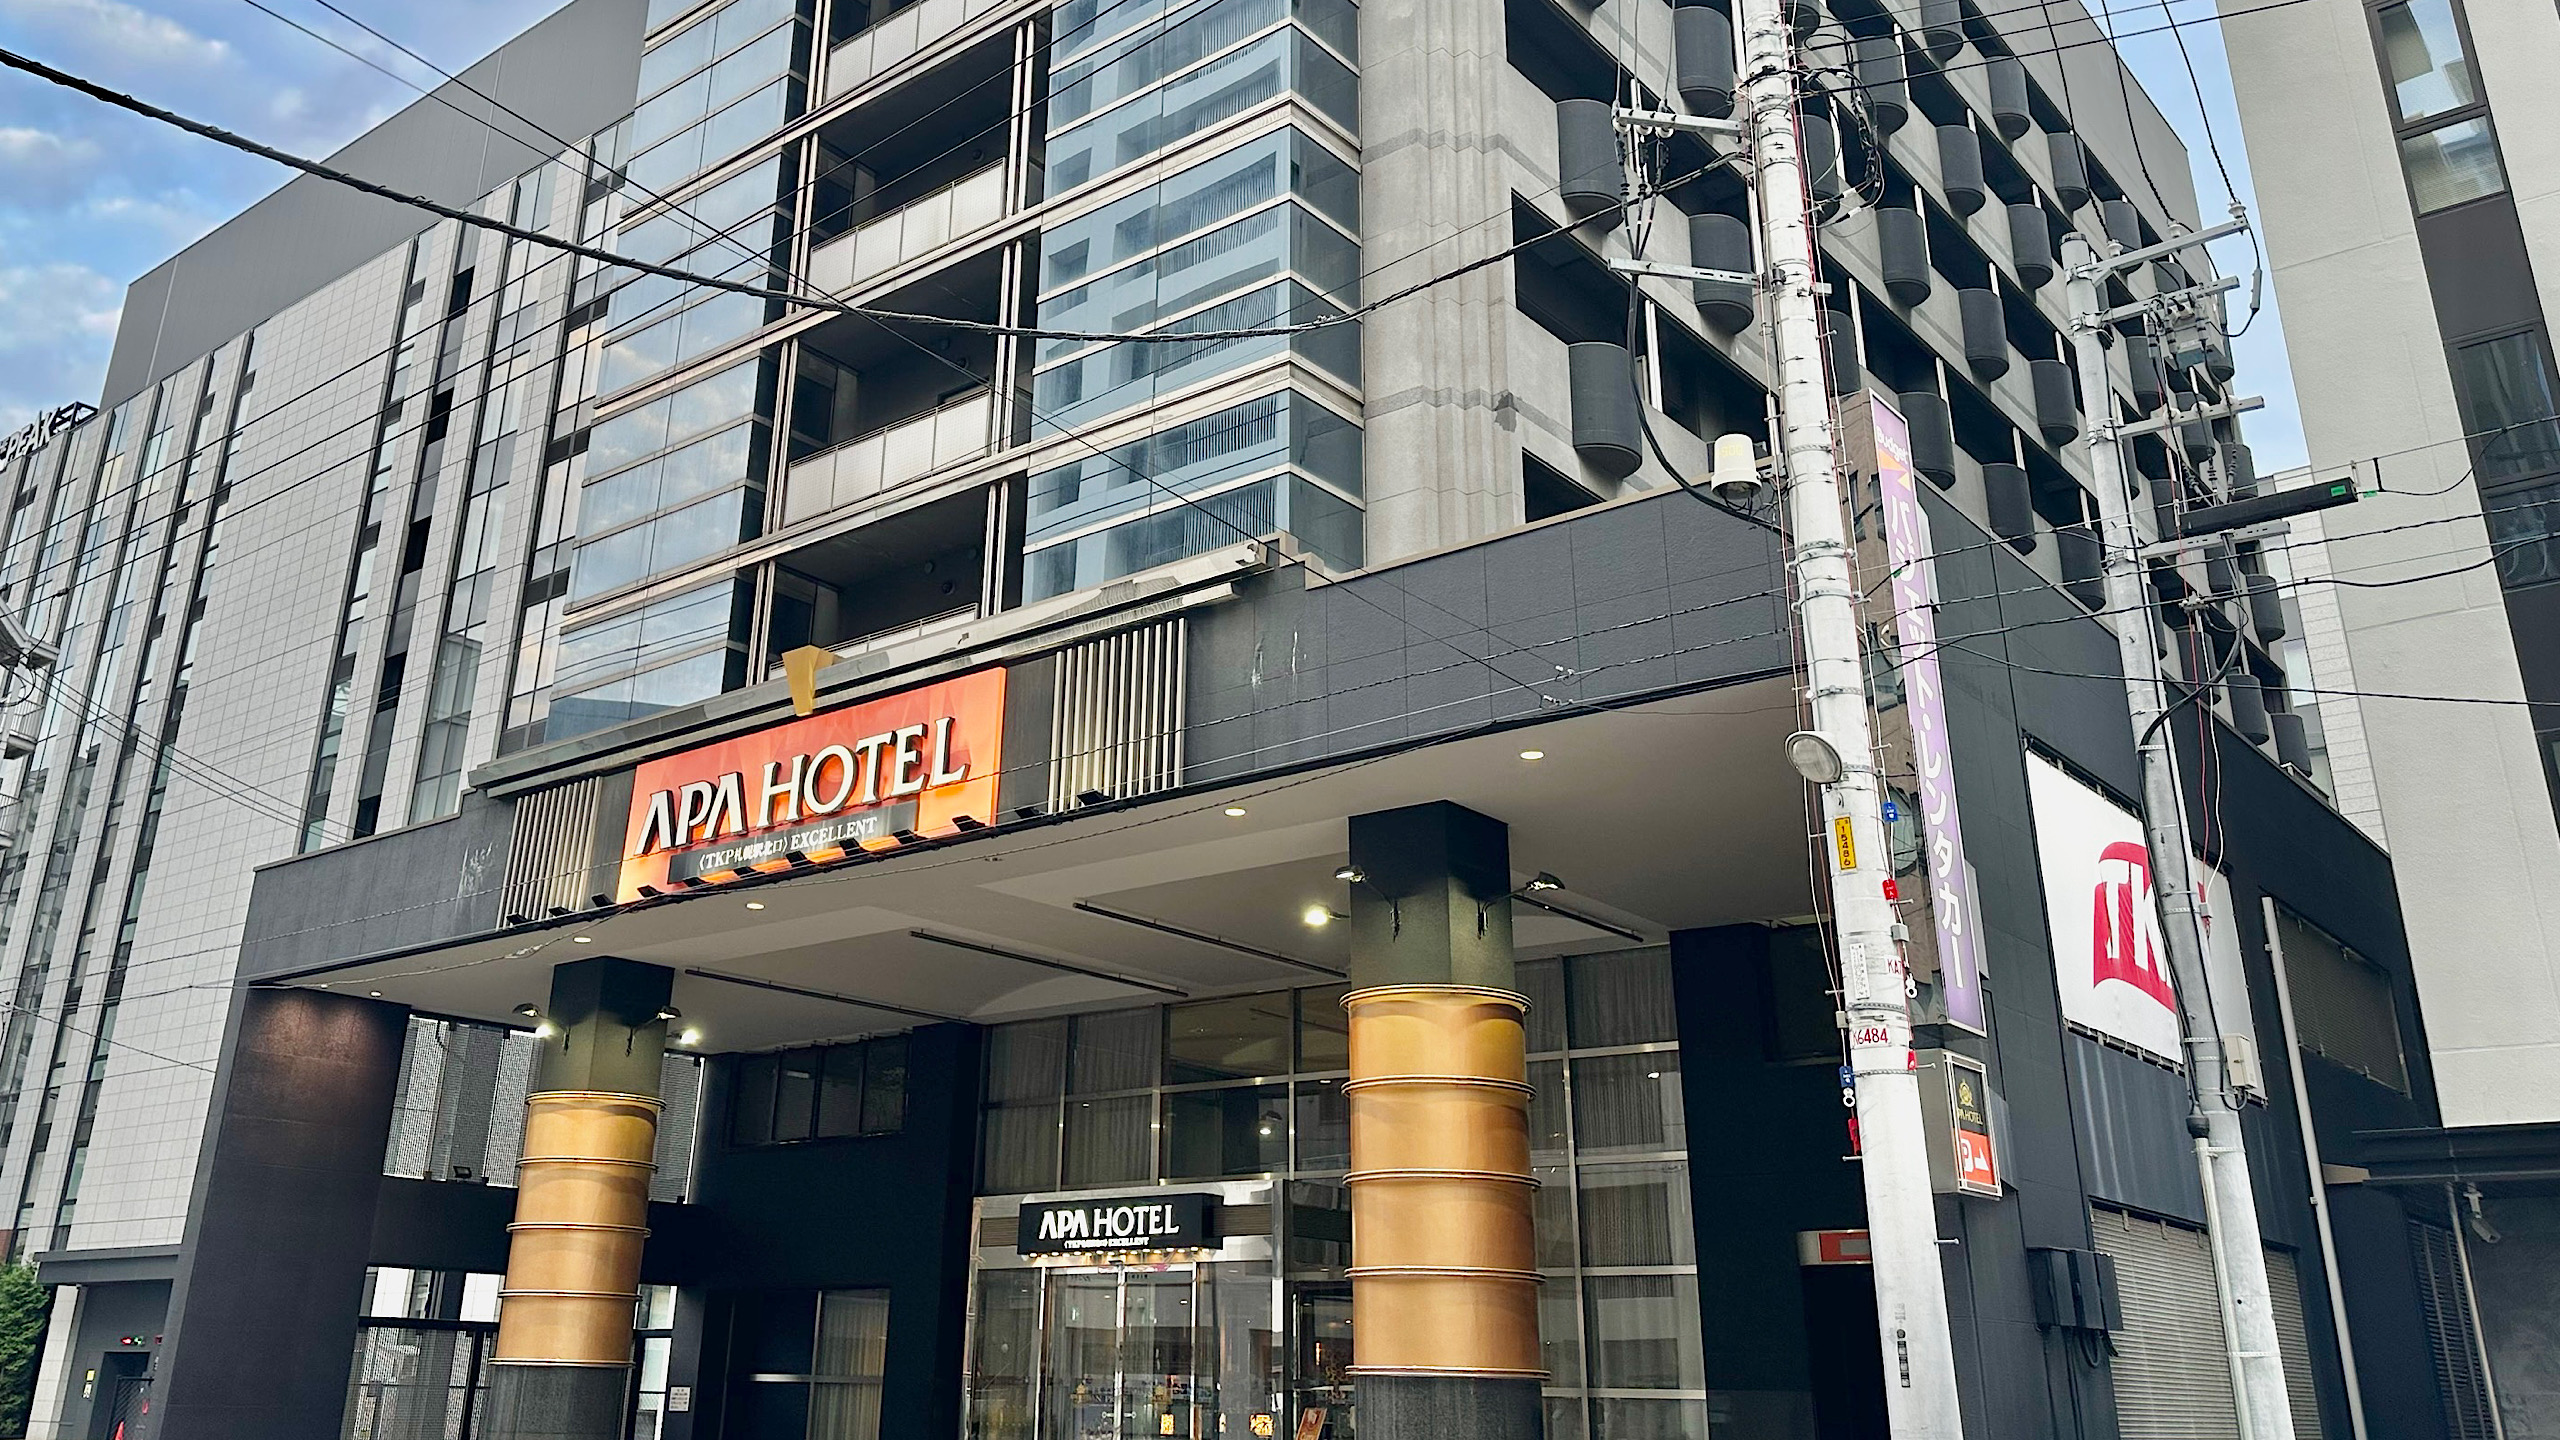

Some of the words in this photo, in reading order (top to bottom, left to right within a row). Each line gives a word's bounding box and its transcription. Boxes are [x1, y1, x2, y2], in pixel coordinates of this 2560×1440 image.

[6, 407, 60, 462] PEAK
[1876, 426, 1909, 465] Budget
[1891, 495, 1964, 989] バジェット・レンタカー
[635, 772, 748, 855] APA
[756, 716, 970, 828] HOTEL
[790, 816, 878, 850] EXCELLENT
[1840, 825, 1851, 866] 15486
[2097, 855, 2175, 993] TK
[1039, 1209, 1089, 1239] APA
[1093, 1204, 1180, 1237] HOTEL
